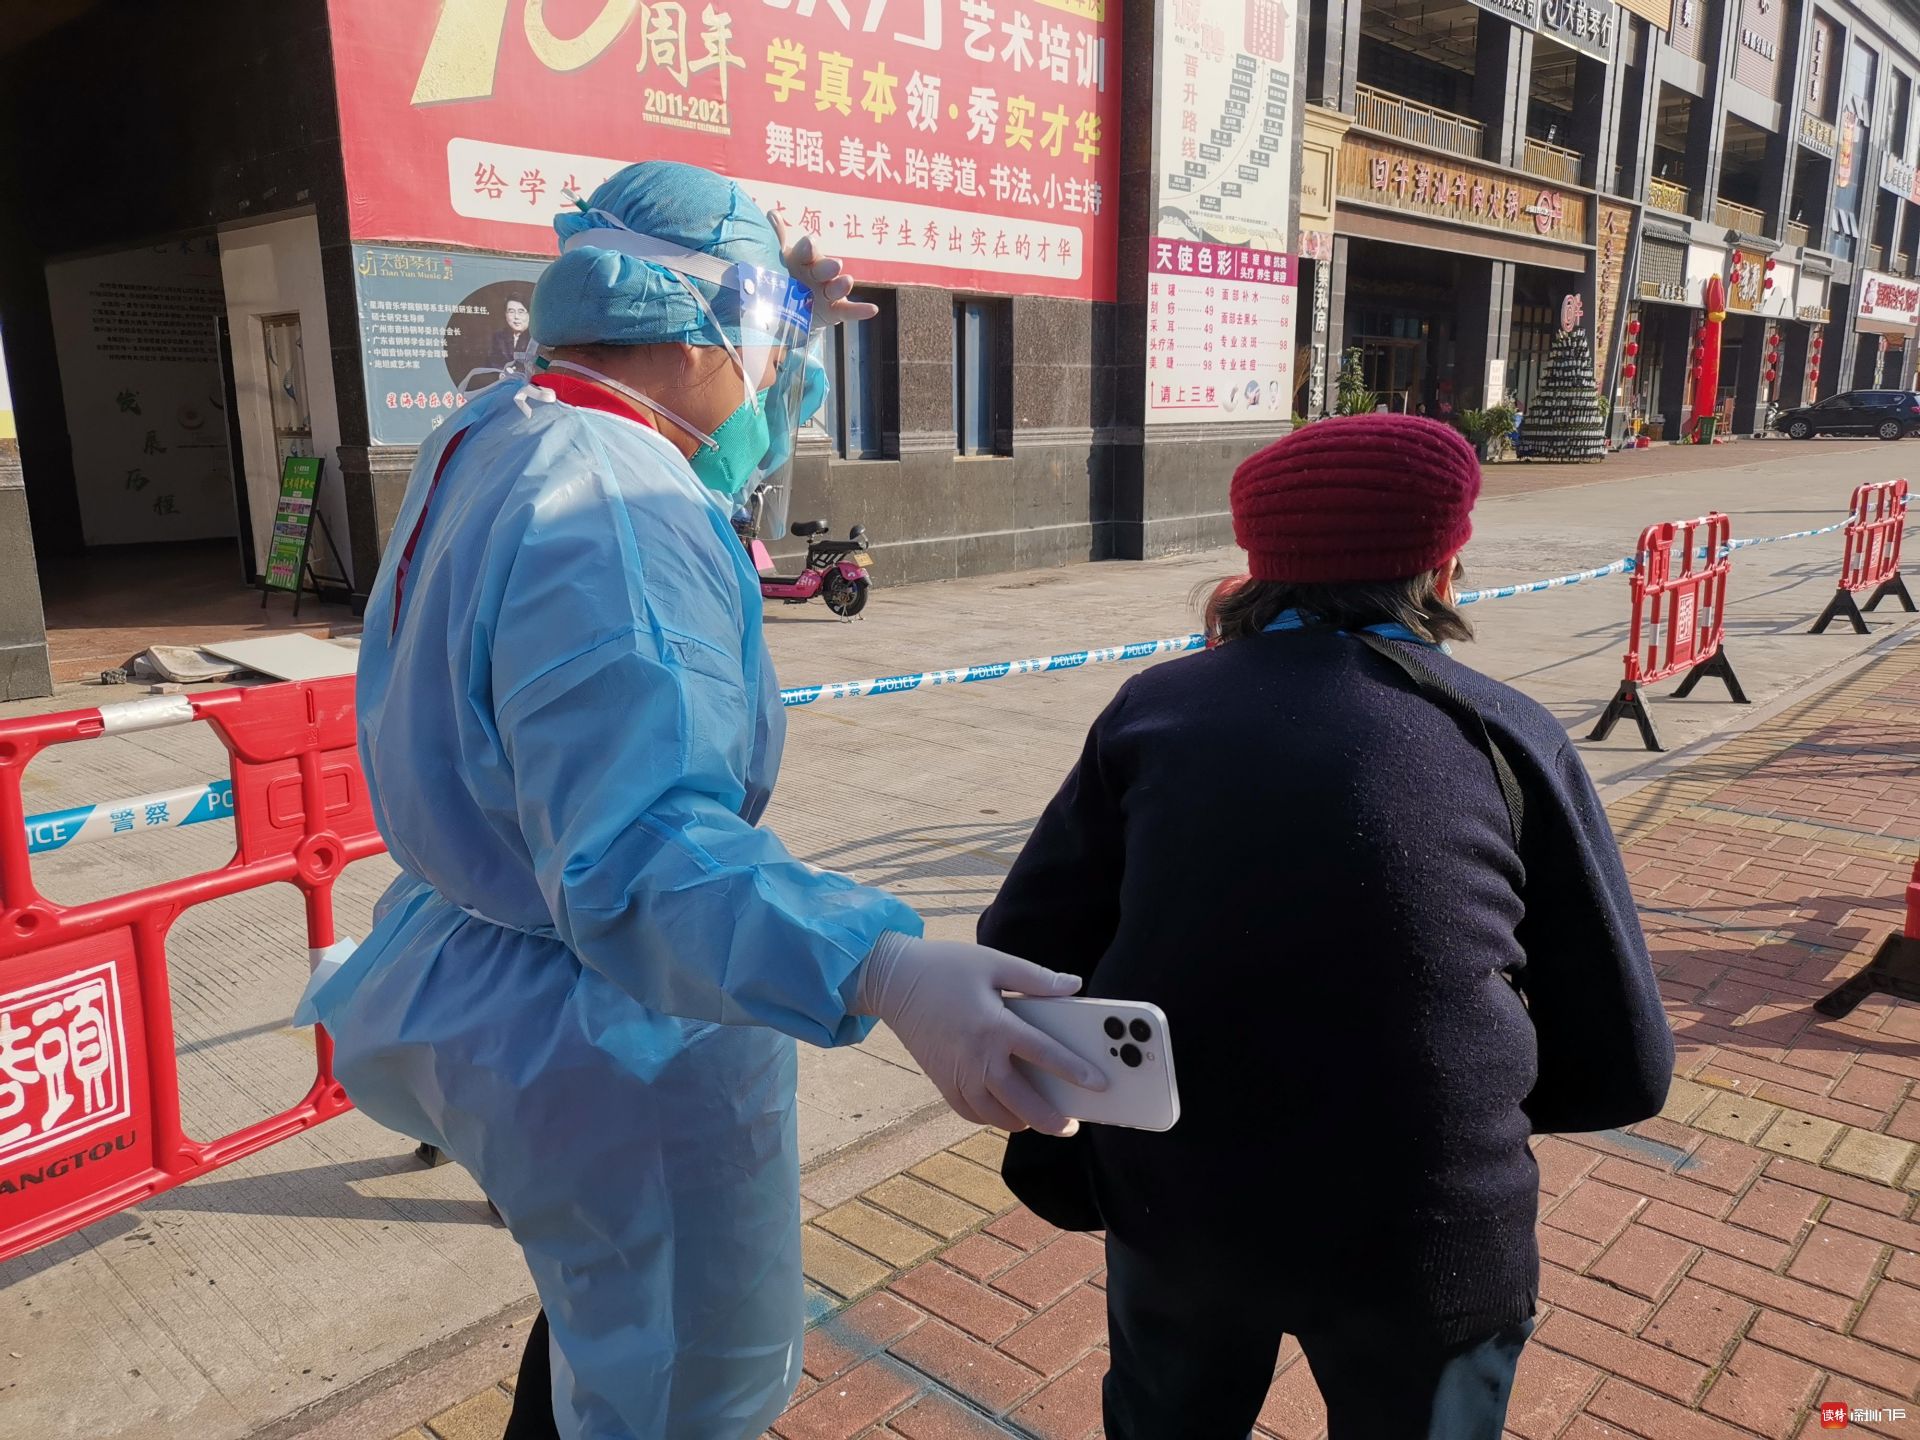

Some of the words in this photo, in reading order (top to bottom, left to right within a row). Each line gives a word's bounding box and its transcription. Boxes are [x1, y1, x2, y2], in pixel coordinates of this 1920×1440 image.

[636, 1, 746, 102] 周年
[960, 0, 1105, 93] 艺术培训
[644, 88, 728, 125] 2011-2021
[765, 37, 1102, 164] 学真本领·秀实才华
[1182, 54, 1199, 160] 晋升路线
[765, 121, 1102, 217] 舞蹈、美术、跆拳道、书法、小主持
[381, 253, 441, 271] 天韵琴行
[1156, 244, 1232, 276] 天使色彩
[381, 269, 399, 278] Tian
[400, 270, 417, 279] Yun
[417, 272, 443, 280] Music
[1205, 287, 1215, 298] 49
[1222, 288, 1259, 303] 面部补水
[1281, 294, 1290, 305] 68
[371, 312, 425, 324] 硕士研究生导师
[1204, 305, 1214, 316] 49
[1150, 319, 1175, 333] 采耳
[1204, 323, 1213, 335] 49
[1221, 312, 1258, 326] 面部去黑头
[1280, 317, 1289, 328] 68
[1203, 342, 1213, 353] 49
[1279, 340, 1288, 351] 98
[1202, 360, 1212, 371] 98
[1278, 363, 1287, 373] 98
[1311, 344, 1325, 406] 下午茶
[1161, 386, 1215, 403] 请上三楼
[878, 676, 915, 692] POLICE
[972, 663, 1006, 679] POLICE
[1053, 652, 1085, 667] POLICE
[1126, 642, 1154, 657] POLICE
[110, 801, 170, 833] 警察
